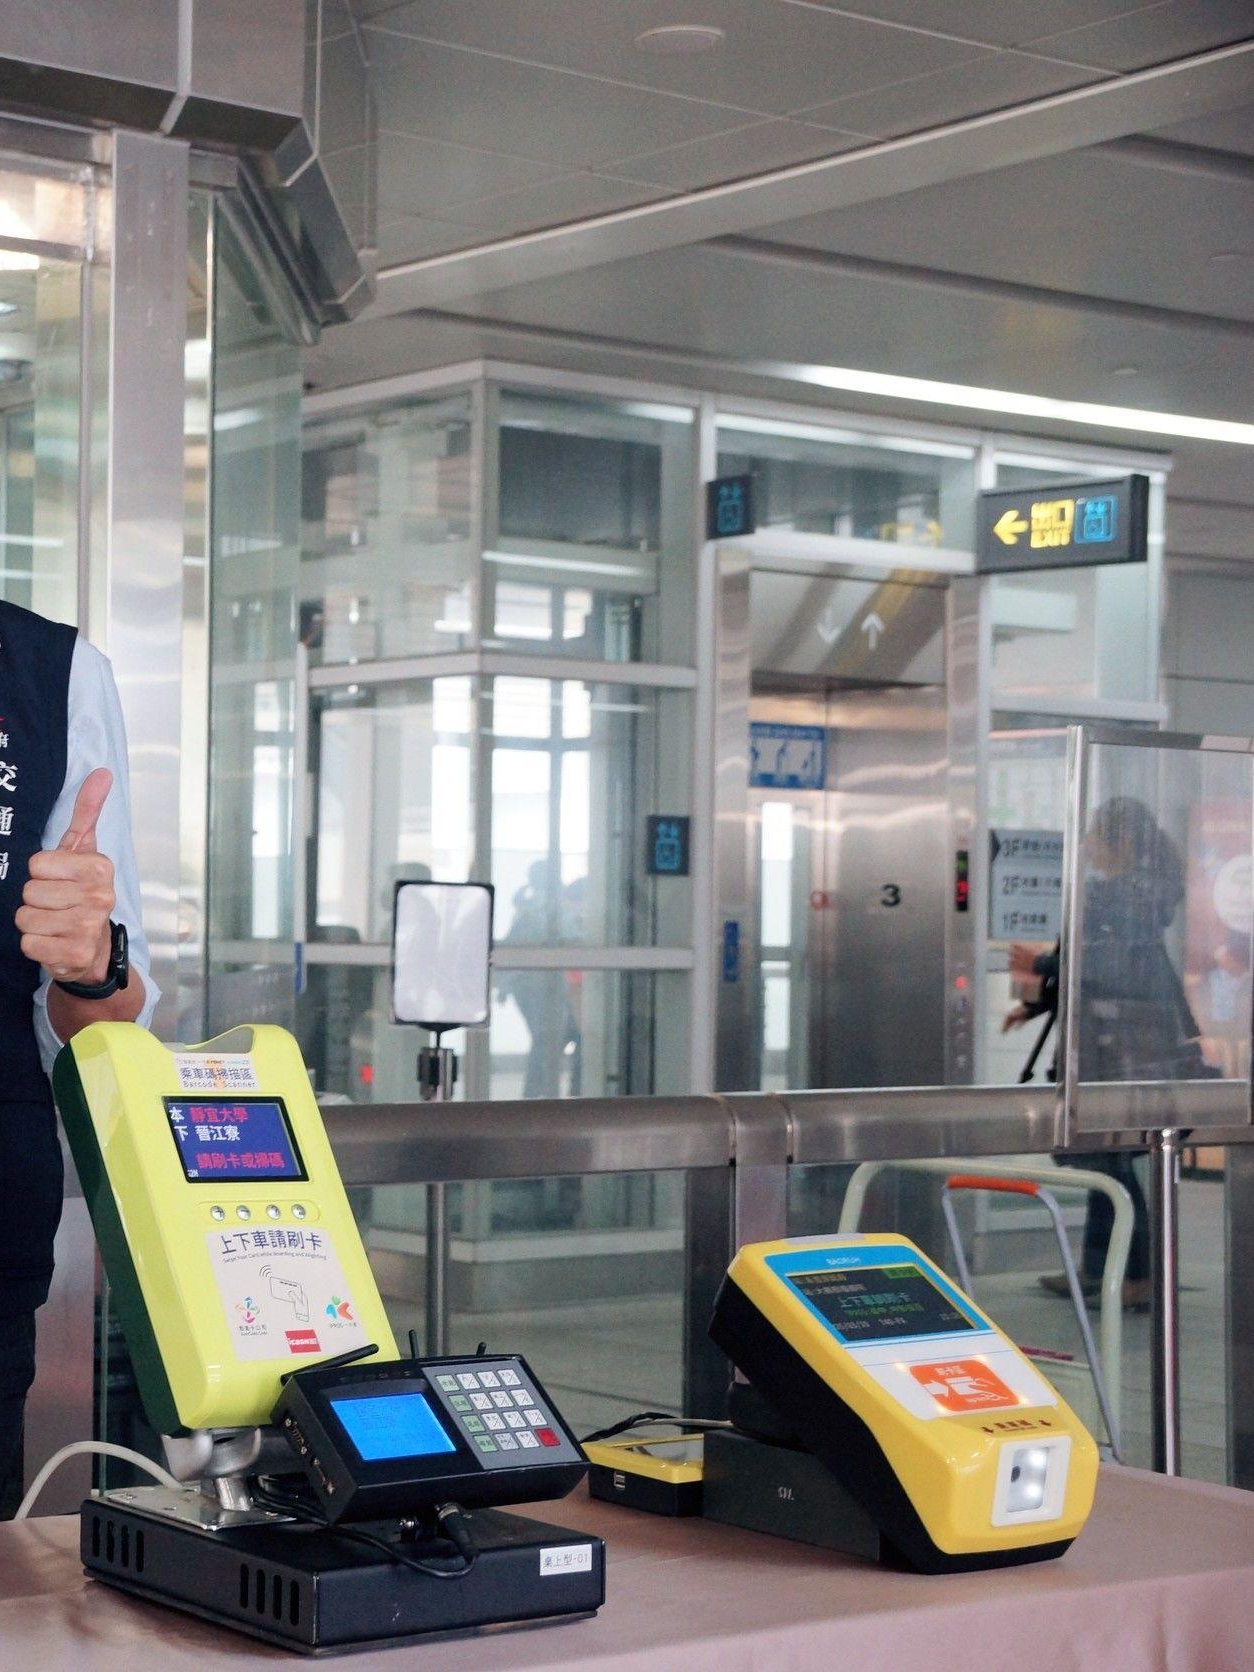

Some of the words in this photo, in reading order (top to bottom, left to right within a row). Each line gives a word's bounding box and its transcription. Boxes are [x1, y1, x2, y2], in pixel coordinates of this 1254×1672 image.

[880, 884, 901, 907] 3
[169, 1106, 185, 1122] 本
[174, 1125, 189, 1142] 下
[221, 1230, 322, 1254] 上下車請刷卡
